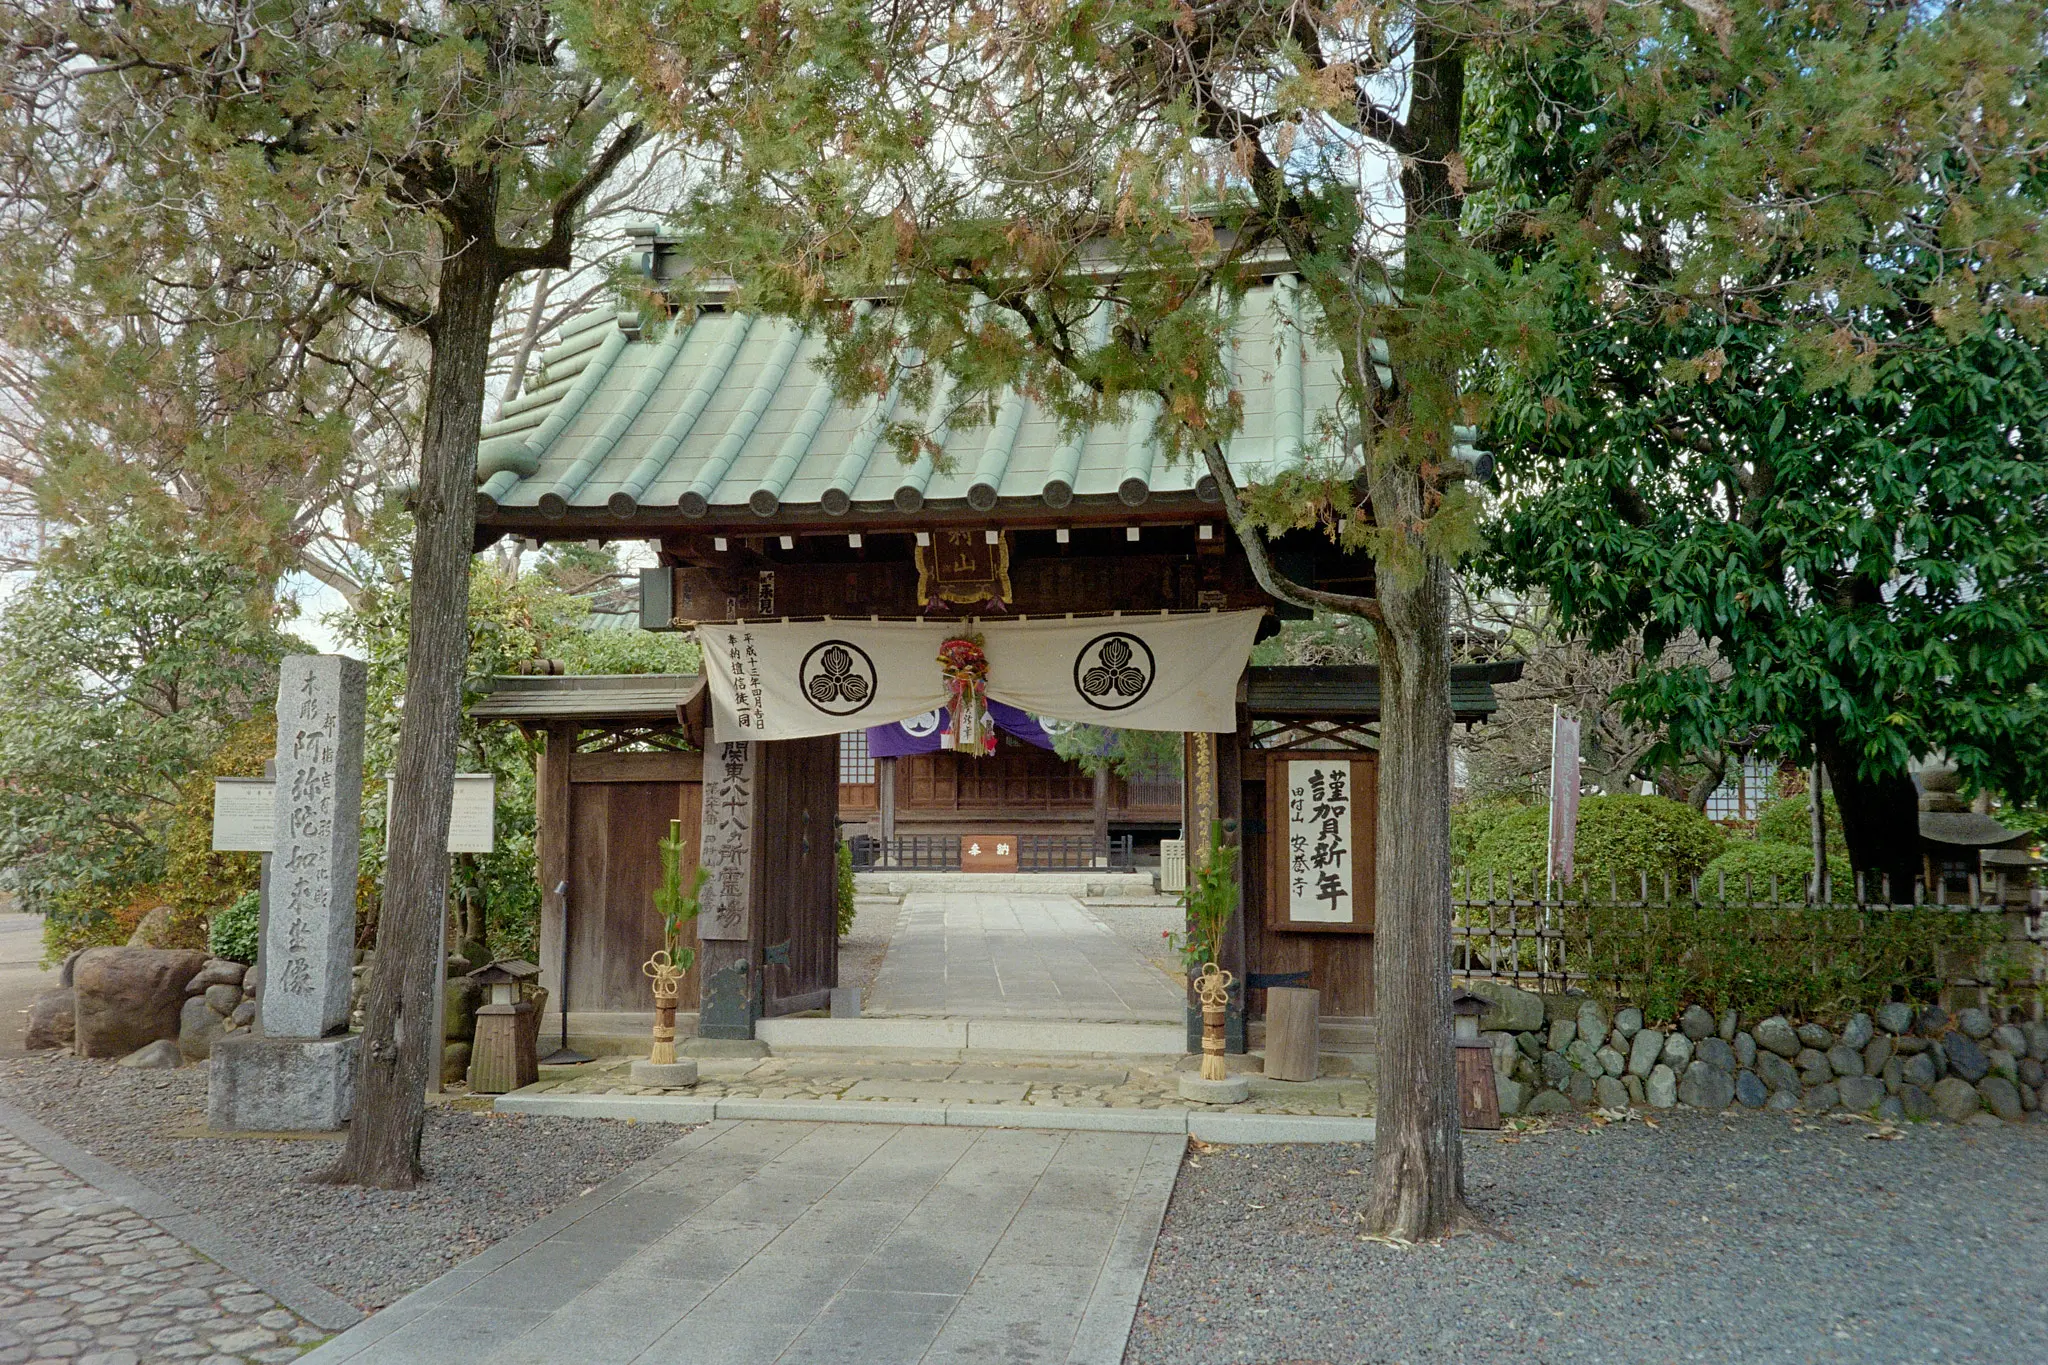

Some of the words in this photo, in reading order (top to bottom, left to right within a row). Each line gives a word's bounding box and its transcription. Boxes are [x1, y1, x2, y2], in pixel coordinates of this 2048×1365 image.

[743, 633, 765, 731] 平成十三年四月吉日
[967, 842, 1010, 857] 奉納
[1290, 832, 1309, 898] 安養寺
[1307, 768, 1350, 911] 謹賀新年
